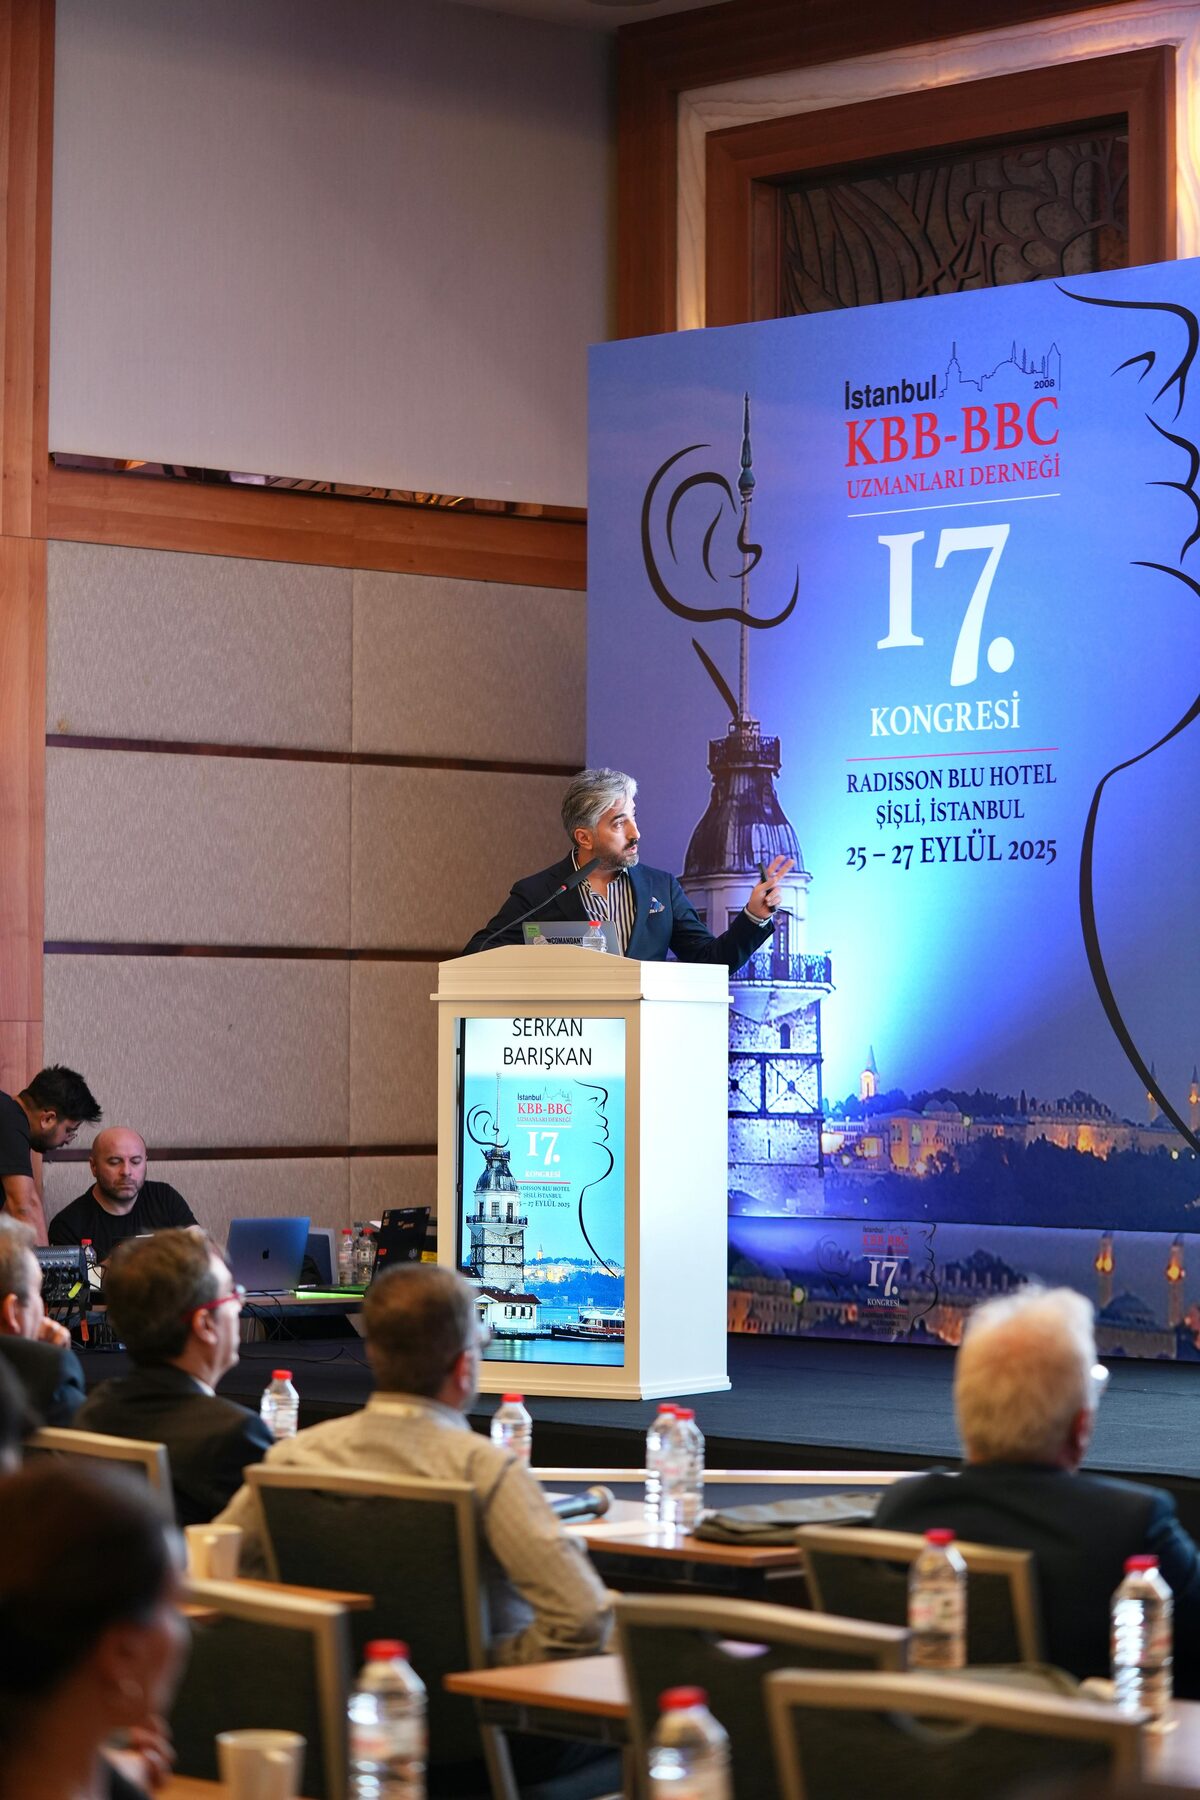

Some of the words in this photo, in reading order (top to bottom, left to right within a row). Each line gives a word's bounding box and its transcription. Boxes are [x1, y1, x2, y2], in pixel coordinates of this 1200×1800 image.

[844, 374, 937, 410] İstanbul
[1033, 378, 1055, 389] 2008
[844, 396, 1059, 467] KBB-BBC
[847, 468, 965, 499] UZMANLARI
[970, 453, 1061, 486] DERNEĞİ
[877, 523, 1015, 687] 17.
[870, 690, 1021, 737] KONGRESİ
[846, 769, 943, 793] RADISSON
[948, 767, 985, 788] BLU
[989, 763, 1057, 786] HOTEL
[876, 798, 926, 829] ŞİŞLİ,
[929, 797, 1025, 822] İSTANBUL
[846, 847, 867, 872] 25
[892, 845, 914, 870] 27
[920, 828, 1002, 863] EYLÜL
[1008, 839, 1057, 866] 2025
[512, 1018, 583, 1037] SERKAN
[503, 1047, 592, 1070] BARIŞKAN
[517, 1102, 573, 1115] KBB-BBC
[527, 1131, 560, 1165] 17.
[868, 1260, 899, 1297] 17.
